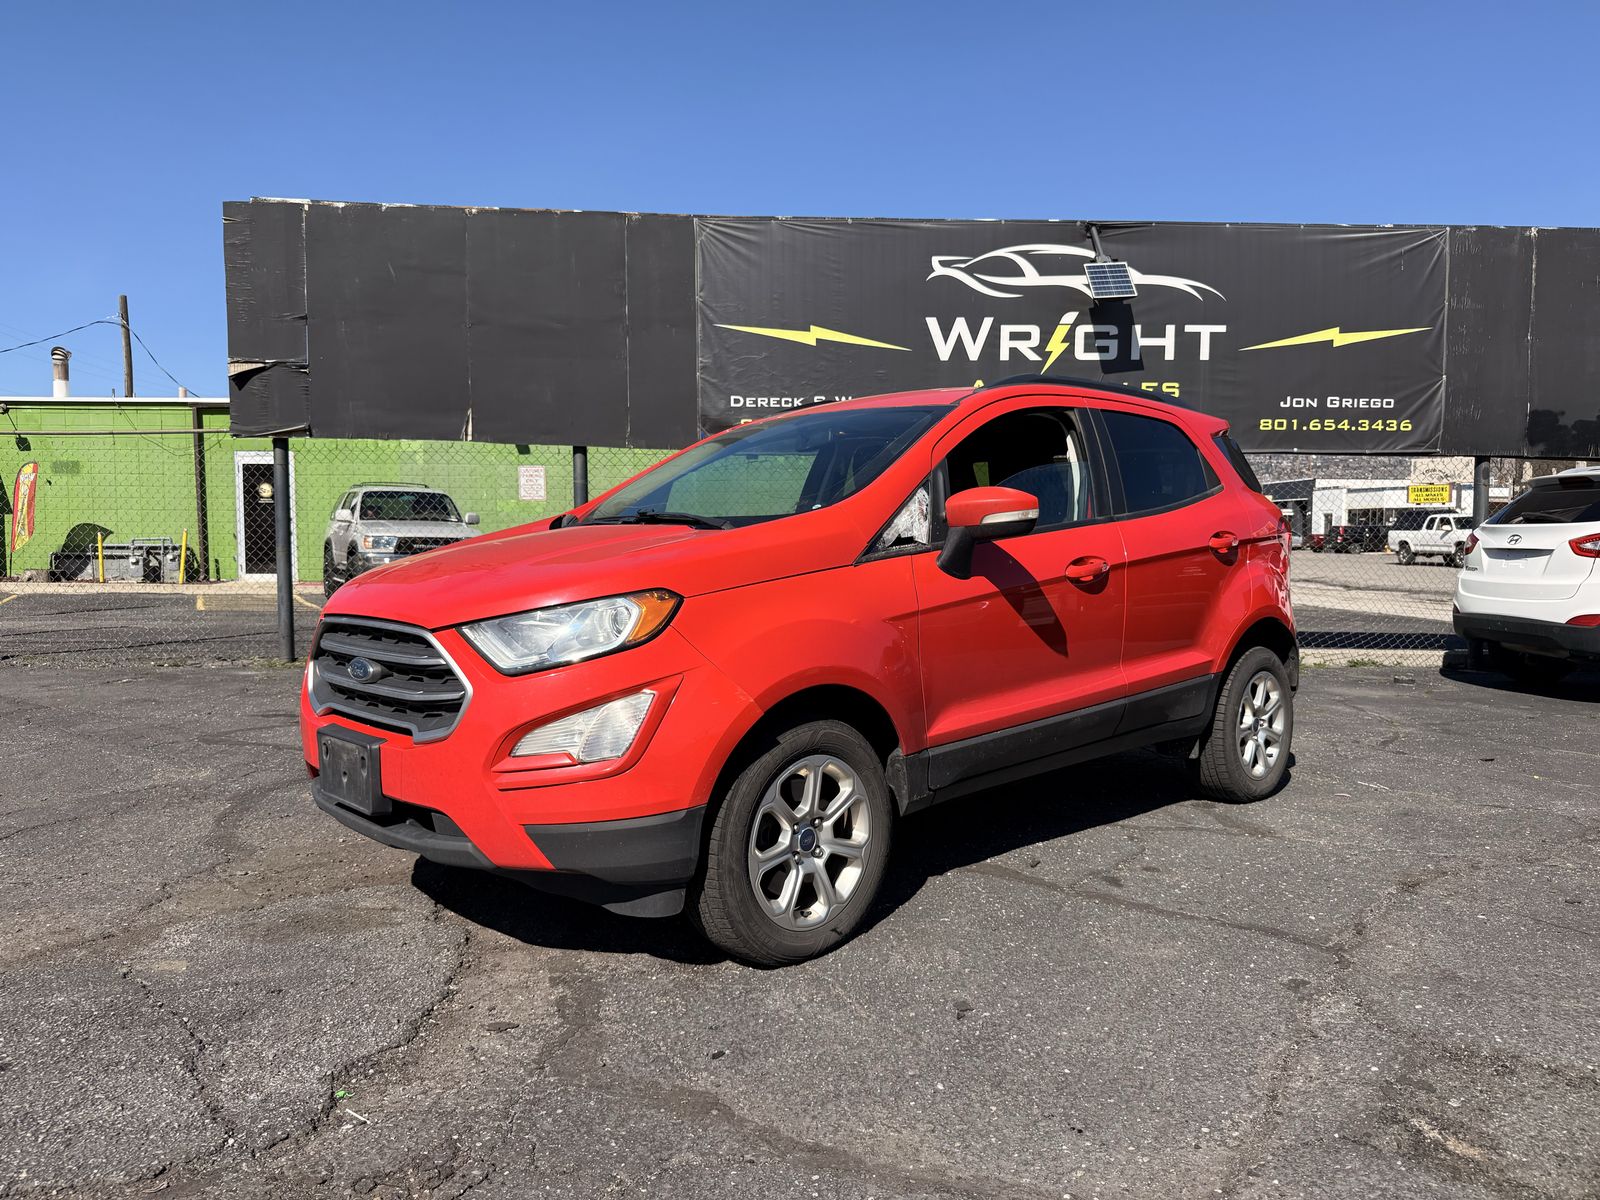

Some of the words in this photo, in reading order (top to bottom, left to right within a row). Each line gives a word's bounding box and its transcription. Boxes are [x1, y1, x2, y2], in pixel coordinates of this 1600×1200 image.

[925, 311, 1227, 375] WRIGHT
[730, 395, 803, 408] DERECK
[1280, 396, 1318, 408] JON
[1327, 396, 1395, 409] GRIEGO
[1259, 418, 1413, 432] 801.654.3436
